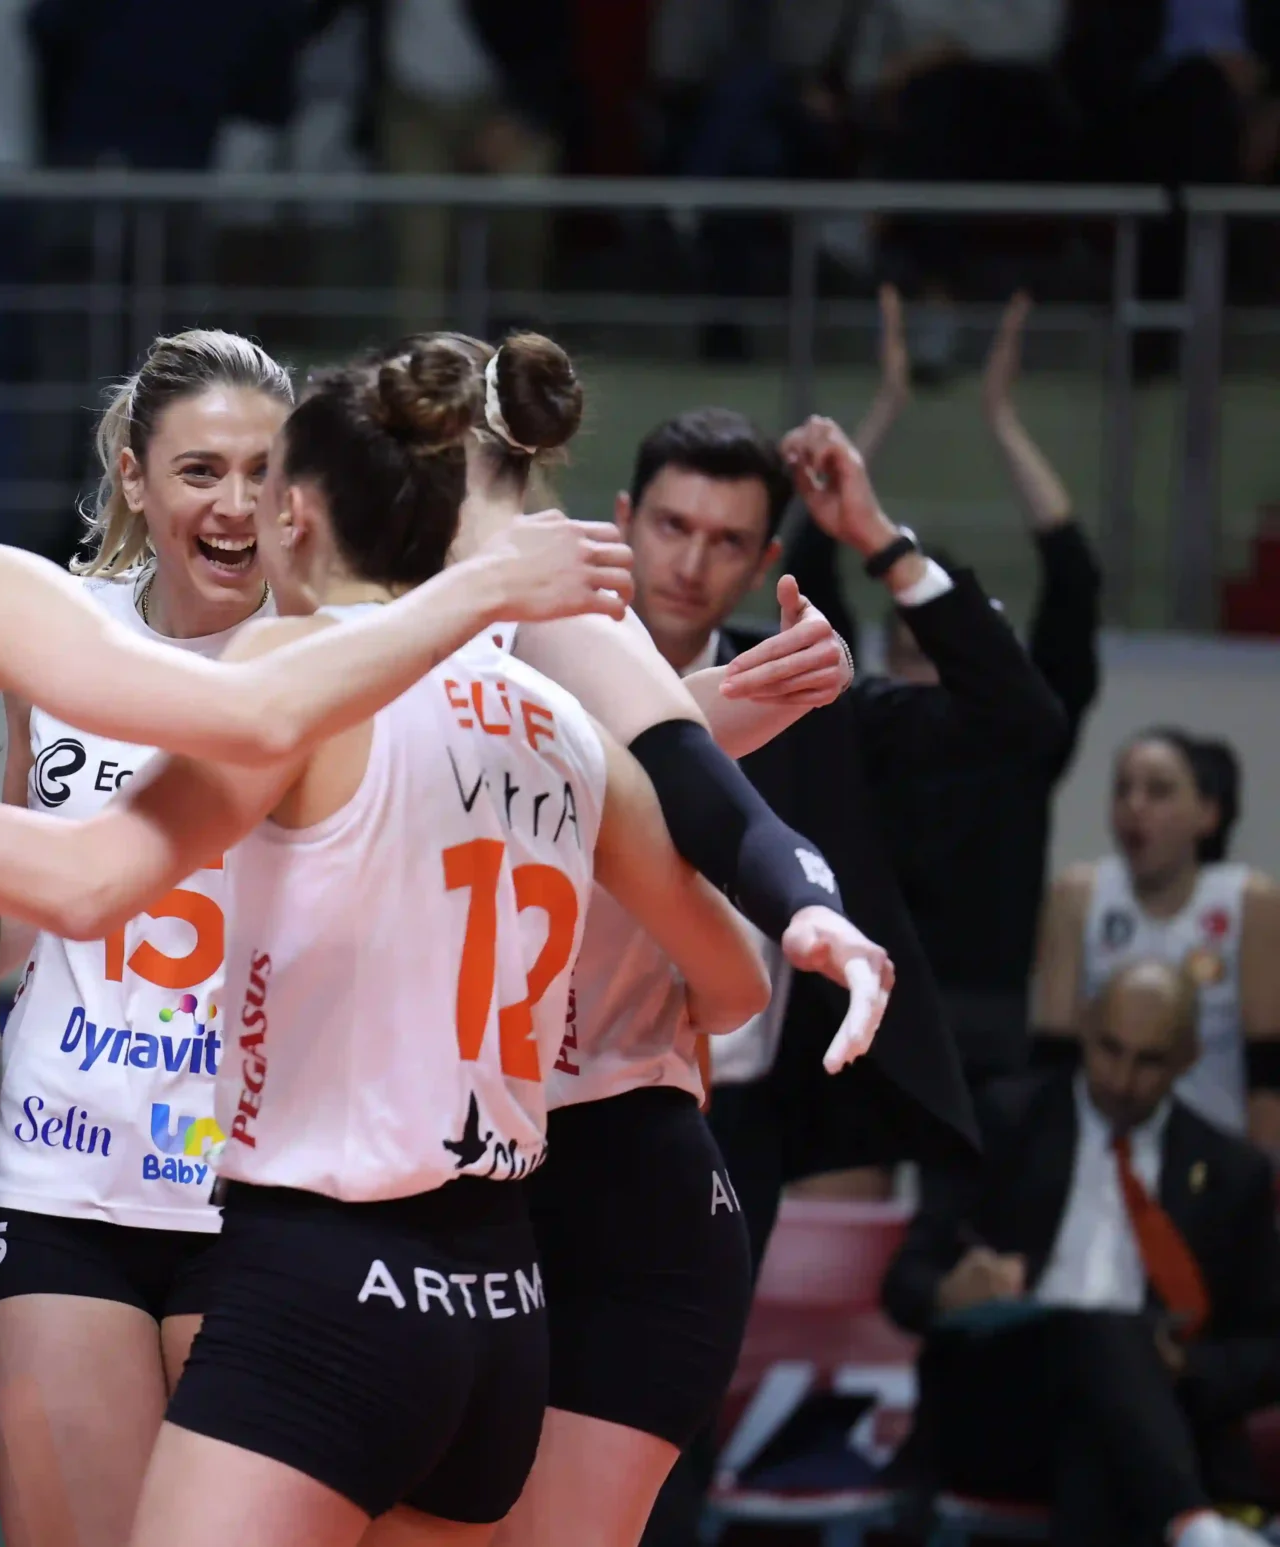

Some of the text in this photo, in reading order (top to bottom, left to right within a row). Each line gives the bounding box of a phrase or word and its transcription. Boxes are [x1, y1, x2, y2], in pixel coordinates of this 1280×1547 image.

[442, 837, 579, 1083] 12
[60, 1006, 221, 1076] Dynavit
[230, 948, 273, 1149] PEGASUS
[14, 1095, 112, 1157] Selin
[142, 1153, 208, 1186] Baby
